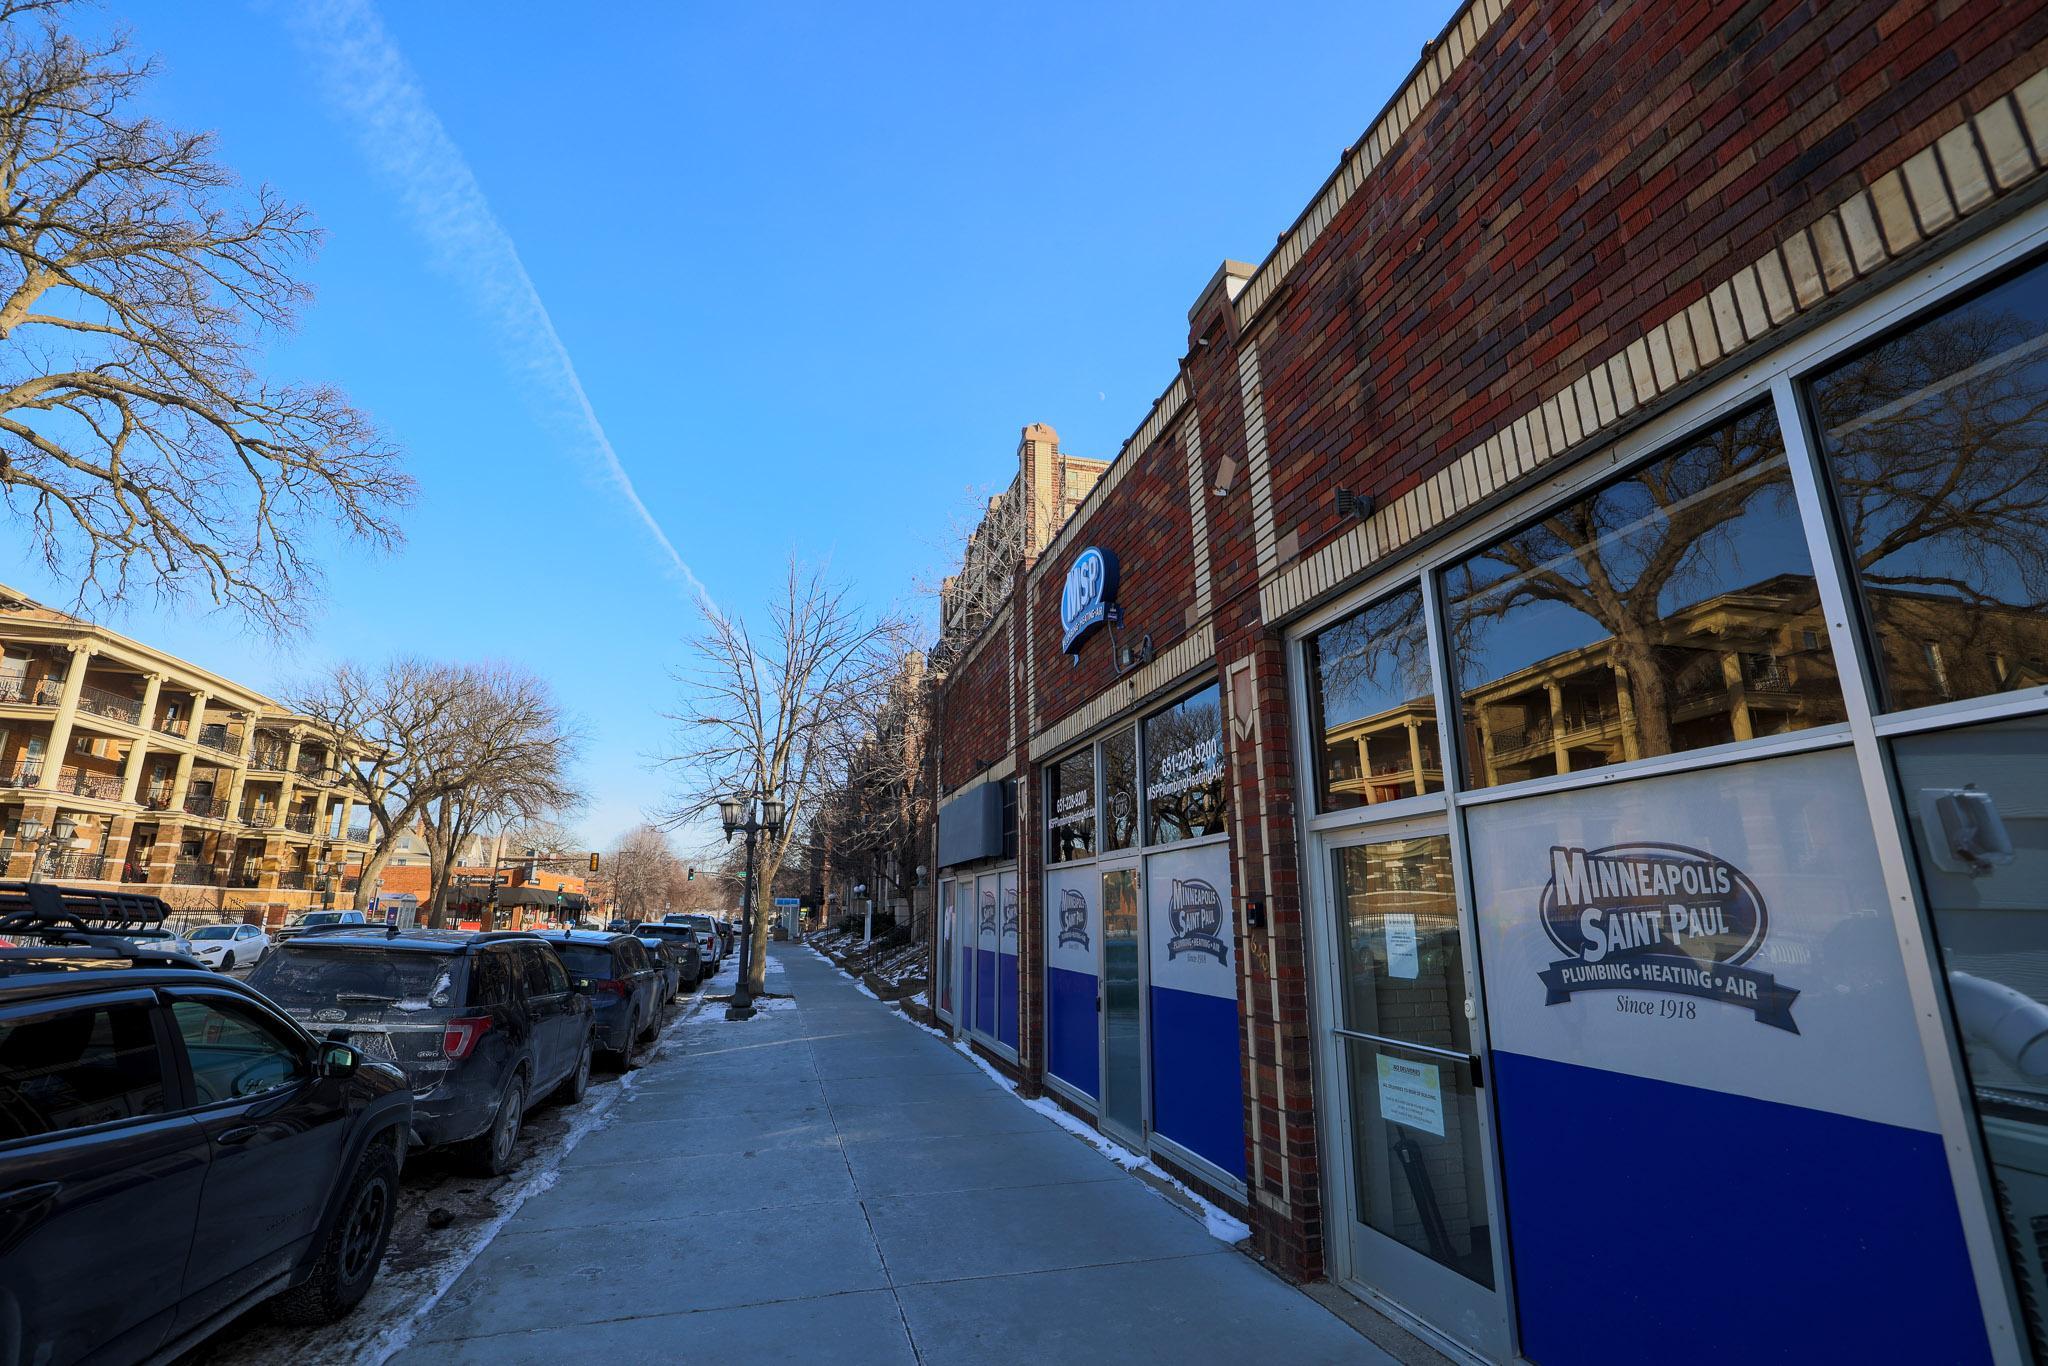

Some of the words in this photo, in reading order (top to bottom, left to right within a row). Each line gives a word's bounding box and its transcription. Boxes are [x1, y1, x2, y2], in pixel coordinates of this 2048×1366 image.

[1066, 555, 1099, 623] MSP
[1161, 737, 1217, 777] 651-228-9200
[1146, 762, 1226, 801] MSPPlumbingHeatingAir.
[1172, 880, 1216, 910] MINNEAPOLIS
[1552, 849, 1732, 907] MINNEAPOLIS
[1178, 910, 1200, 938] SAINT
[1200, 908, 1215, 929] PAUL
[1580, 907, 1662, 963] SAINT
[1668, 903, 1729, 946] PAUL
[1561, 962, 1632, 984] PLUMBING
[1642, 966, 1713, 990] HEATING
[1725, 975, 1758, 1000] AIR
[1616, 994, 1655, 1016] Since
[1659, 998, 1697, 1020] 1918
